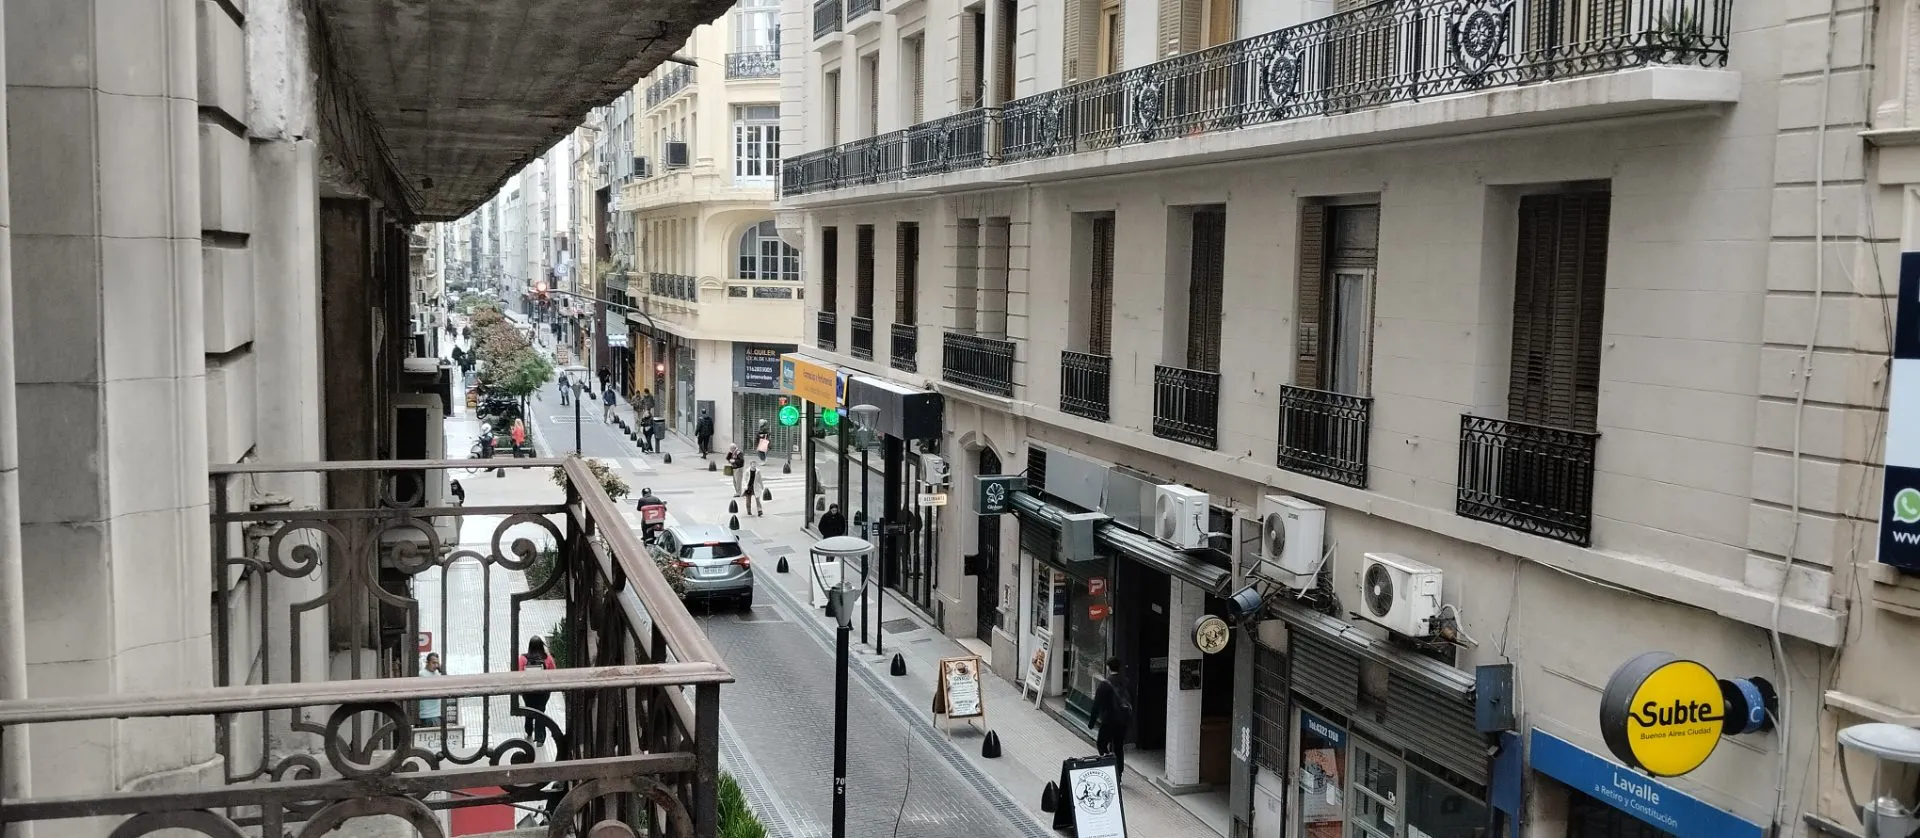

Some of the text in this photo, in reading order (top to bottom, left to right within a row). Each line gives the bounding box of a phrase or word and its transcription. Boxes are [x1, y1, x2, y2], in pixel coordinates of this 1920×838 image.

[1637, 700, 1717, 728] Subte
[1640, 727, 1712, 740] Buenos Aires Ciudad
[1613, 772, 1660, 805] Lavalle
[1601, 786, 1624, 802] Retiro
[1624, 797, 1630, 808] y
[1630, 798, 1678, 828] Constitución
